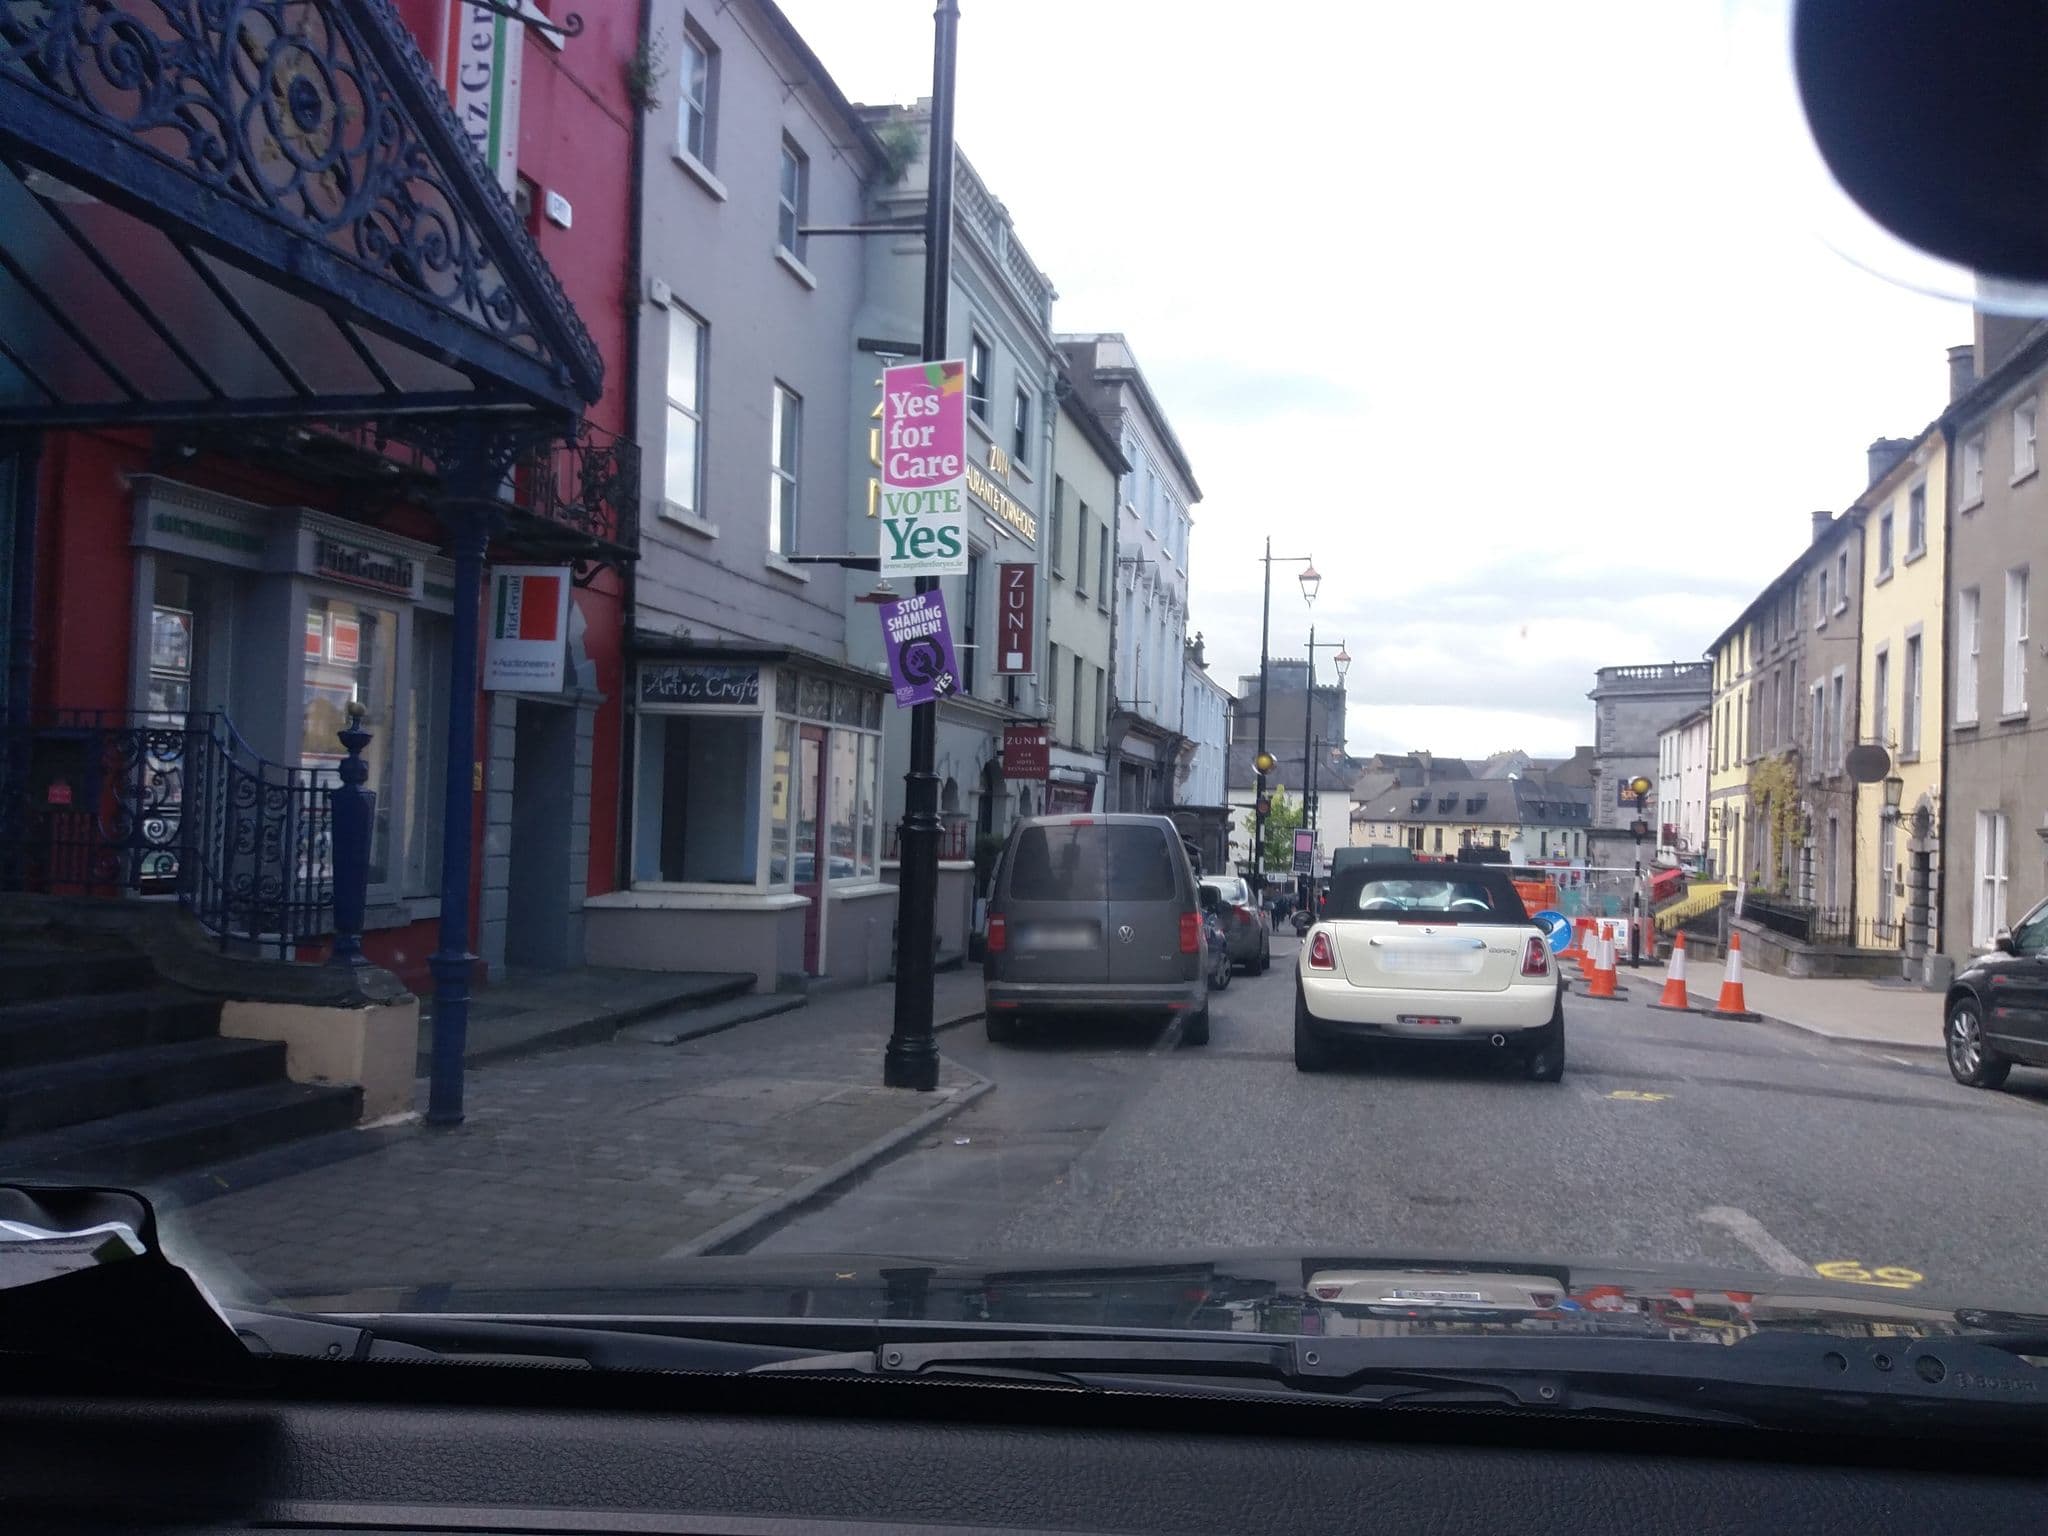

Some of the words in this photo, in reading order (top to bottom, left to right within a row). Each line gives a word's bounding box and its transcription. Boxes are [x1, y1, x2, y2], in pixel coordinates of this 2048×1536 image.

[889, 391, 940, 418] Yes
[890, 420, 935, 449] for
[890, 453, 959, 480] Care
[885, 489, 962, 516] VOTE
[965, 464, 994, 508] AURANT
[1000, 493, 1036, 542] TOWNHOUSE
[883, 517, 962, 560] Yes
[506, 575, 520, 640] FitzGerald
[887, 605, 942, 631] SHAMING
[897, 596, 926, 615] STOP
[1008, 570, 1025, 650] ZUNI
[892, 619, 941, 643] WOMEN!
[933, 672, 953, 694] YES
[1006, 736, 1037, 745] ZUNI
